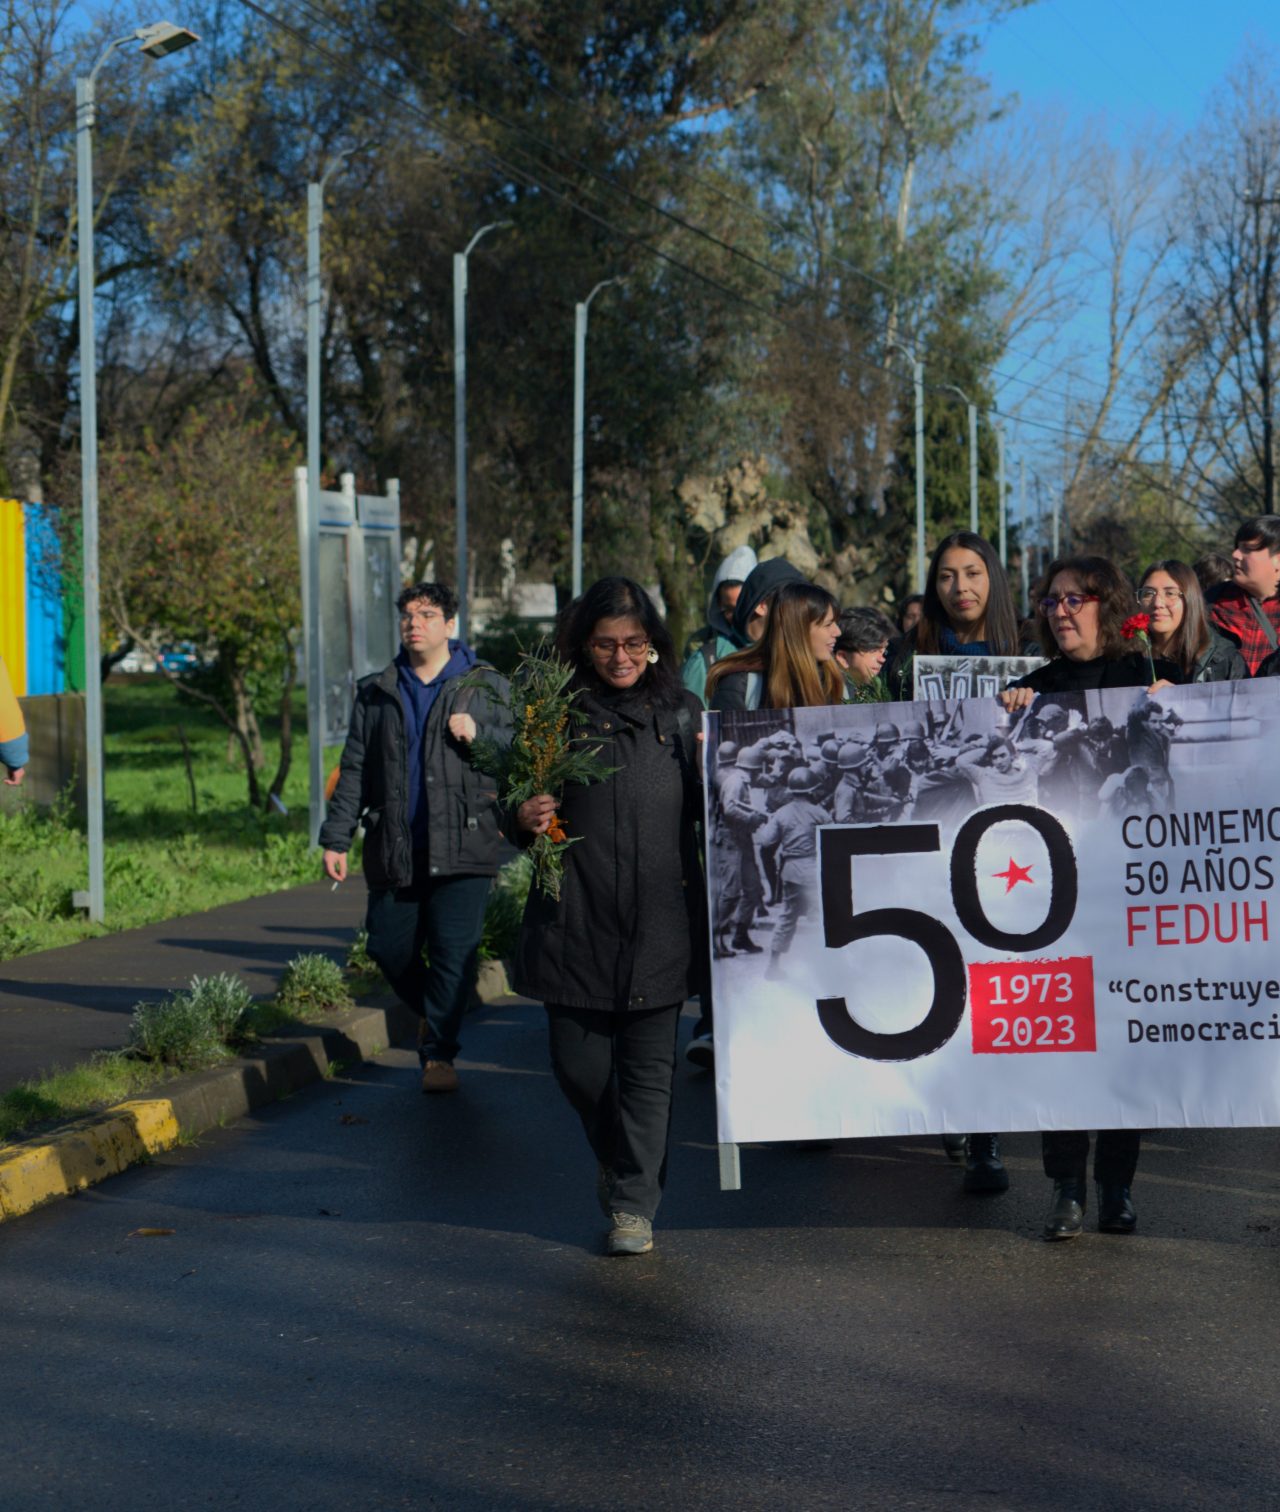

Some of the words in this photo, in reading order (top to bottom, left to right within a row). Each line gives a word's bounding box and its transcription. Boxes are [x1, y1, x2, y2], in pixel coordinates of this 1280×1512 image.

[1124, 861, 1169, 896] 50
[1180, 847, 1275, 894] AÑOS
[816, 804, 1078, 1063] 50
[1126, 900, 1269, 947] FEDUH
[988, 972, 1073, 1005] 1973
[991, 1015, 1076, 1047] 2023
